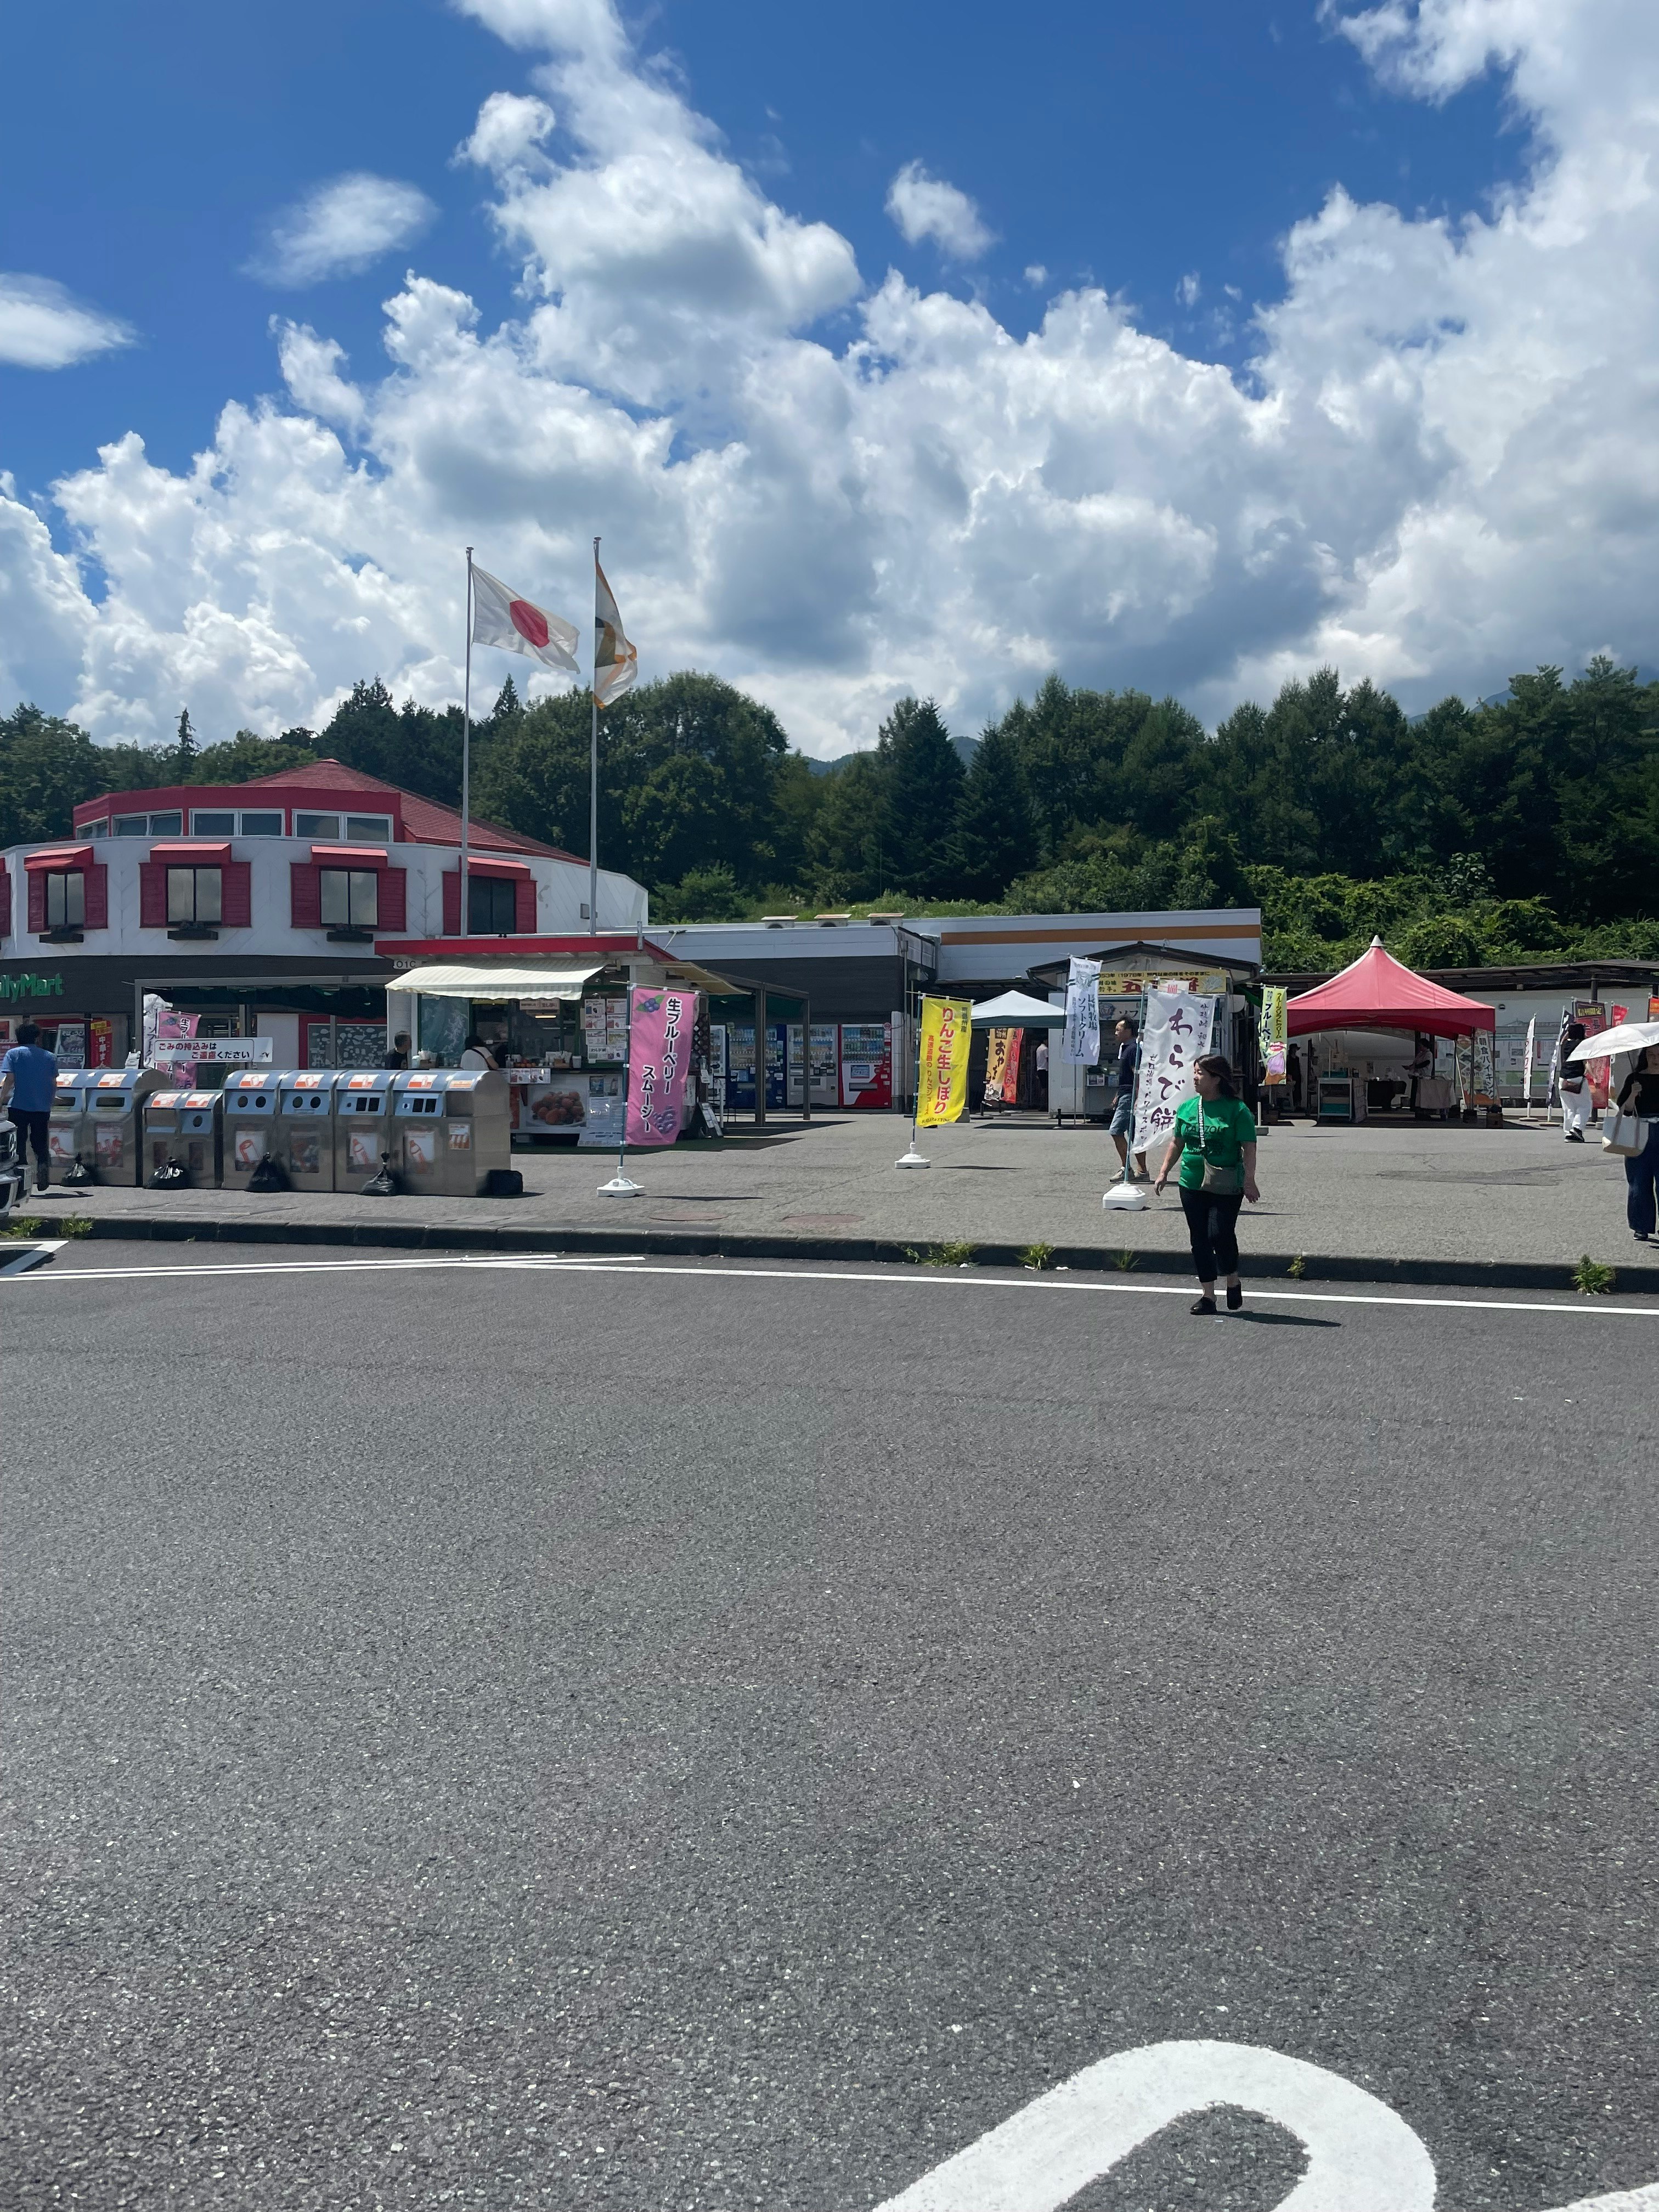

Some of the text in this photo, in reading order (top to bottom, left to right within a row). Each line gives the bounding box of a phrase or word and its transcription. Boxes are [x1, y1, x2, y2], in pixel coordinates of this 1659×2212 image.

[1075, 997, 1086, 1057] ソフトクリーム
[934, 1007, 954, 1114] りんご生しぼり
[642, 1065, 656, 1131] スムージー
